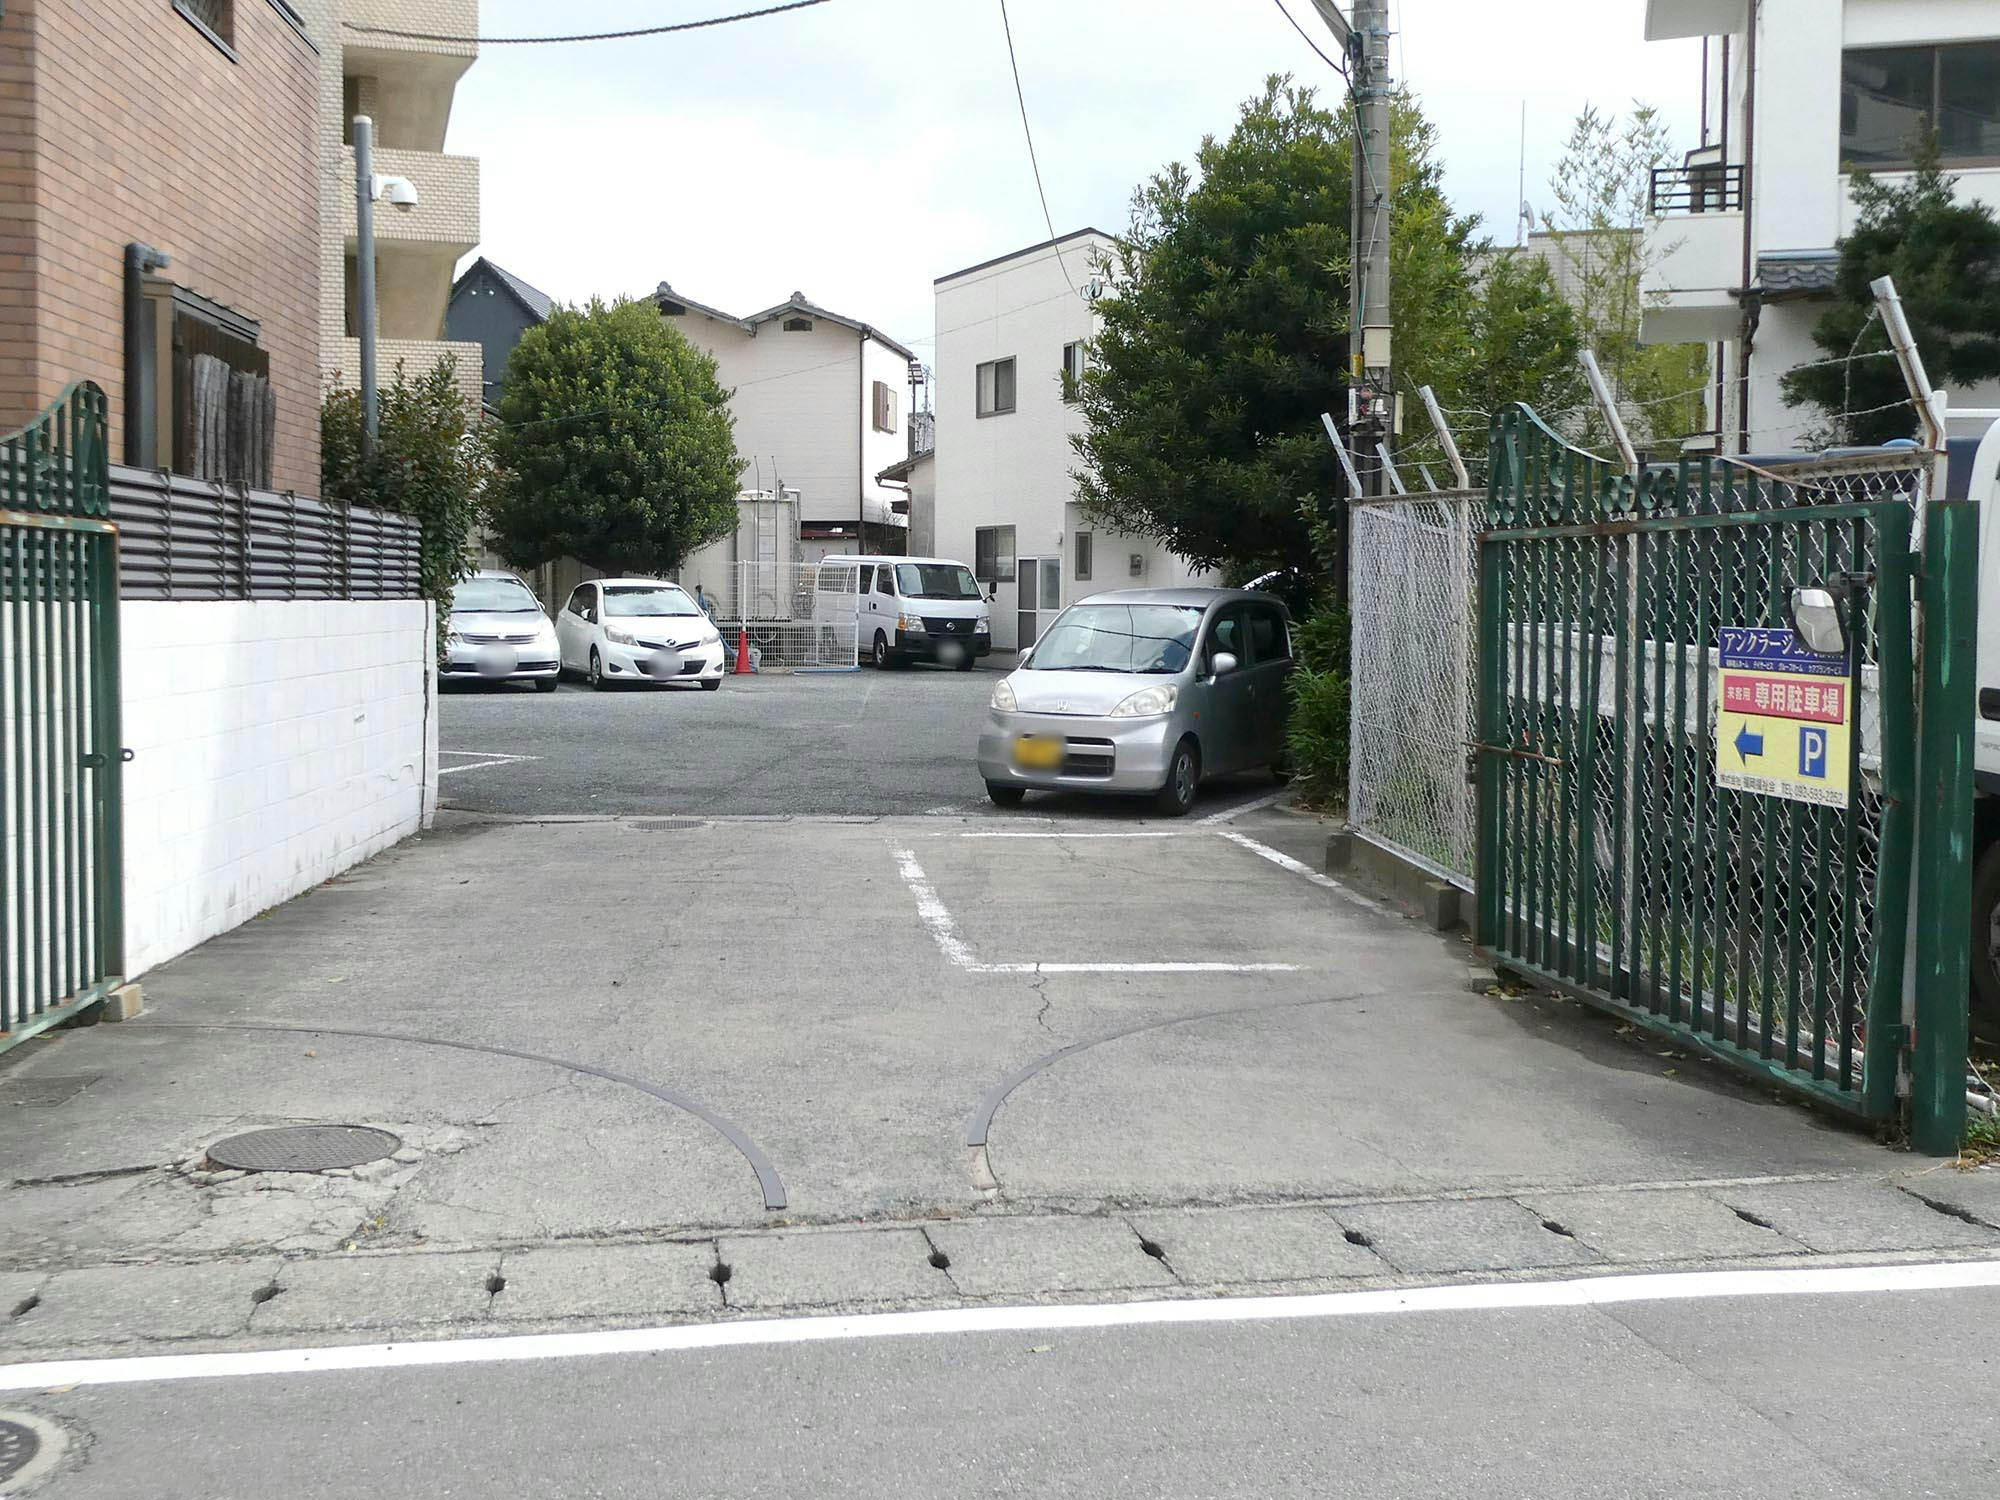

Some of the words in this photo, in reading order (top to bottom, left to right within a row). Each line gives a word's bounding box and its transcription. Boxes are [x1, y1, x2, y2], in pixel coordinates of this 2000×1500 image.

[1754, 682, 1839, 717] 専用駐車場
[1804, 731, 1823, 772] P
